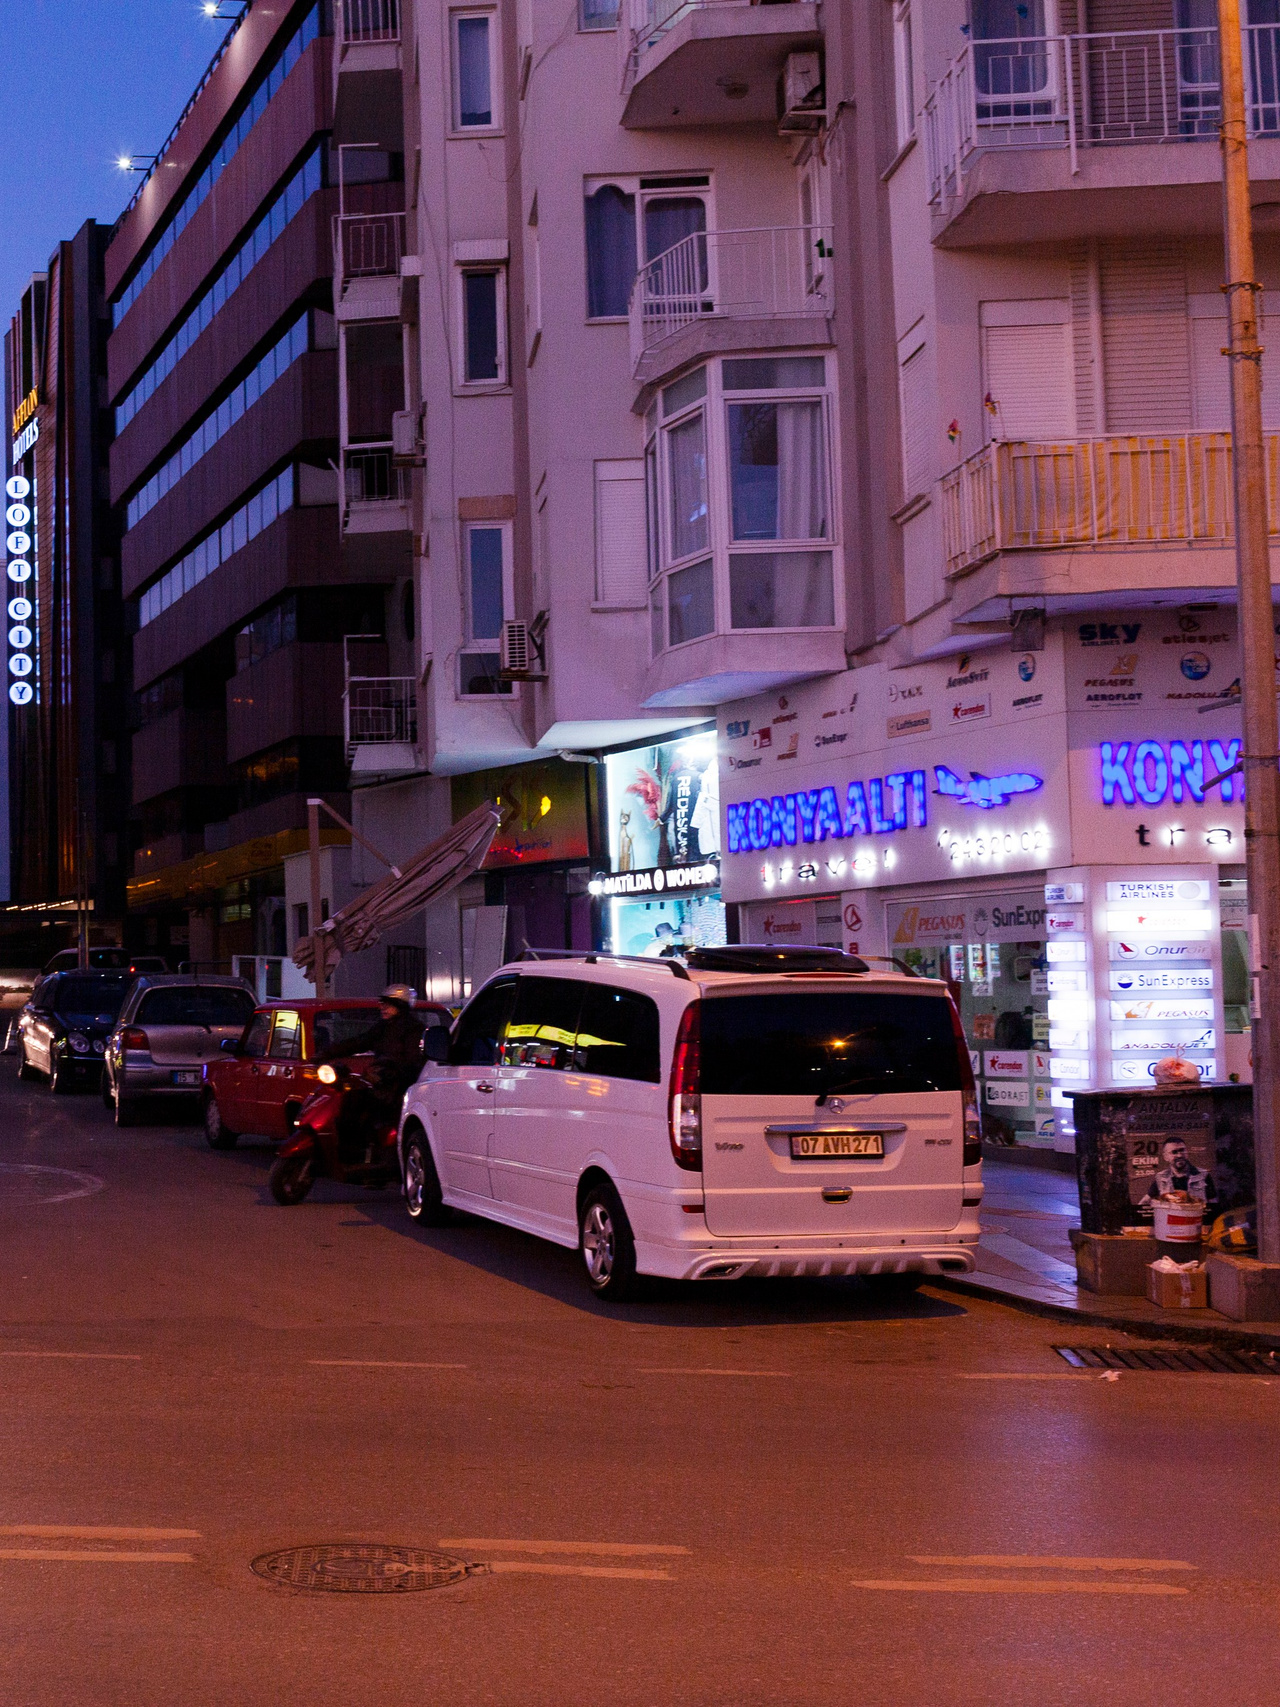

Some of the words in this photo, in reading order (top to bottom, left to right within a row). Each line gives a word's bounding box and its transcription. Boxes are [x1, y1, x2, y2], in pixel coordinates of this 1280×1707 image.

[12, 416, 39, 466] HOTELS
[11, 478, 28, 578] LOFT
[12, 600, 29, 701] CITY
[1086, 692, 1143, 701] AEROFLOT
[1100, 738, 1245, 805] KONY
[726, 769, 927, 853] KONYAALTI
[760, 847, 895, 882] travel
[1120, 883, 1175, 891] TURKISH
[917, 913, 966, 932] PEGASUS
[1138, 974, 1211, 988] SunExpress
[1157, 1009, 1210, 1018] PEGASUS
[1120, 1041, 1209, 1049] ANADOLUJET
[1147, 1062, 1213, 1077] Cor
[800, 1137, 819, 1155] 07
[823, 1136, 851, 1154] AVH
[852, 1136, 881, 1154] 271
[1133, 1140, 1159, 1156] 20
